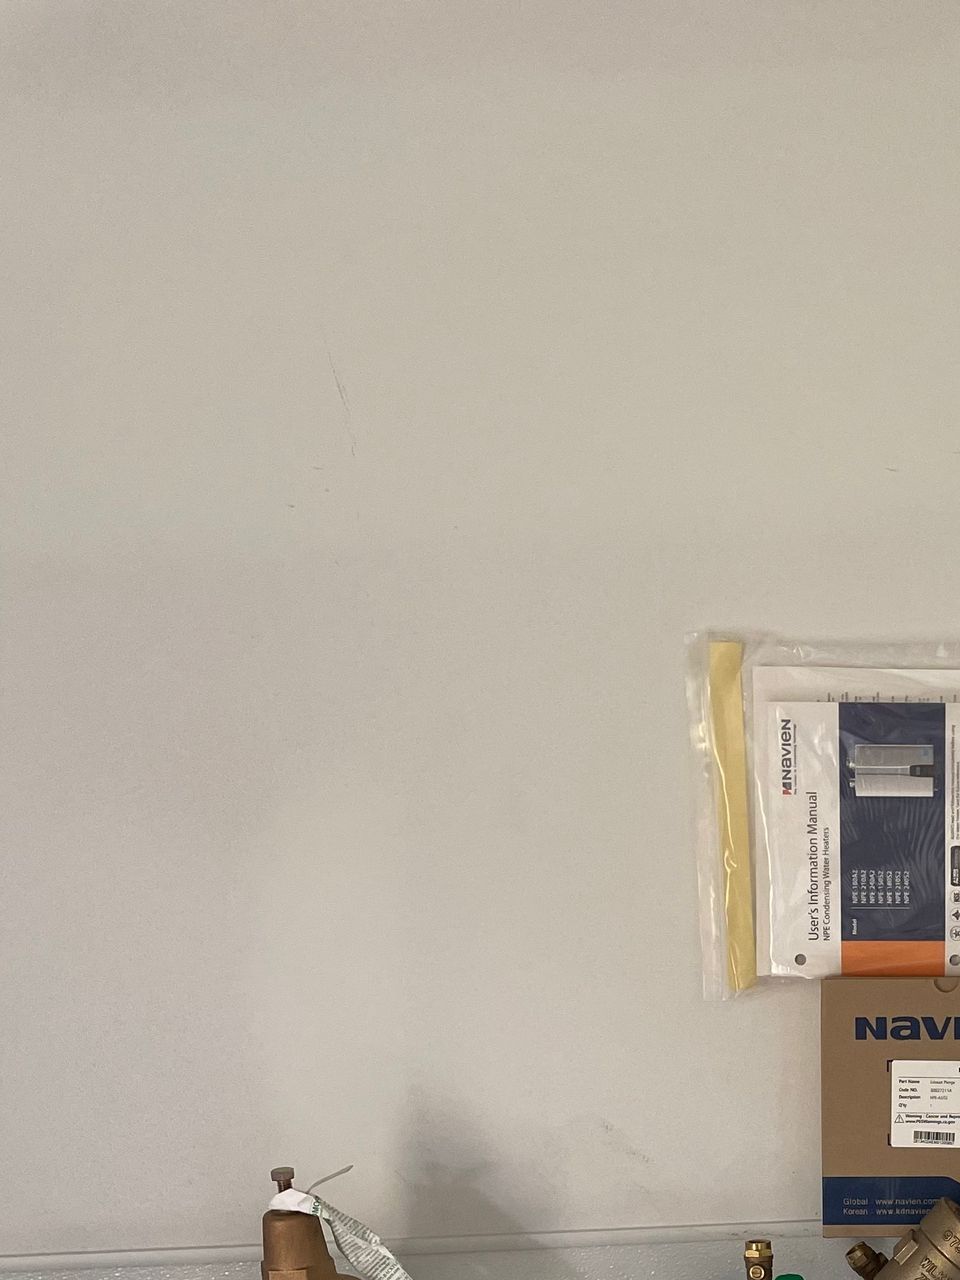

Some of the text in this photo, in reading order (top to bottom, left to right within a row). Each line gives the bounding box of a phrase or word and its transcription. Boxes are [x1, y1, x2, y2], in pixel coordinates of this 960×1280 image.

[806, 791, 819, 940] User's Information Manual
[822, 827, 832, 941] NPE Condensing Water Heaters
[843, 1198, 868, 1206] Global
